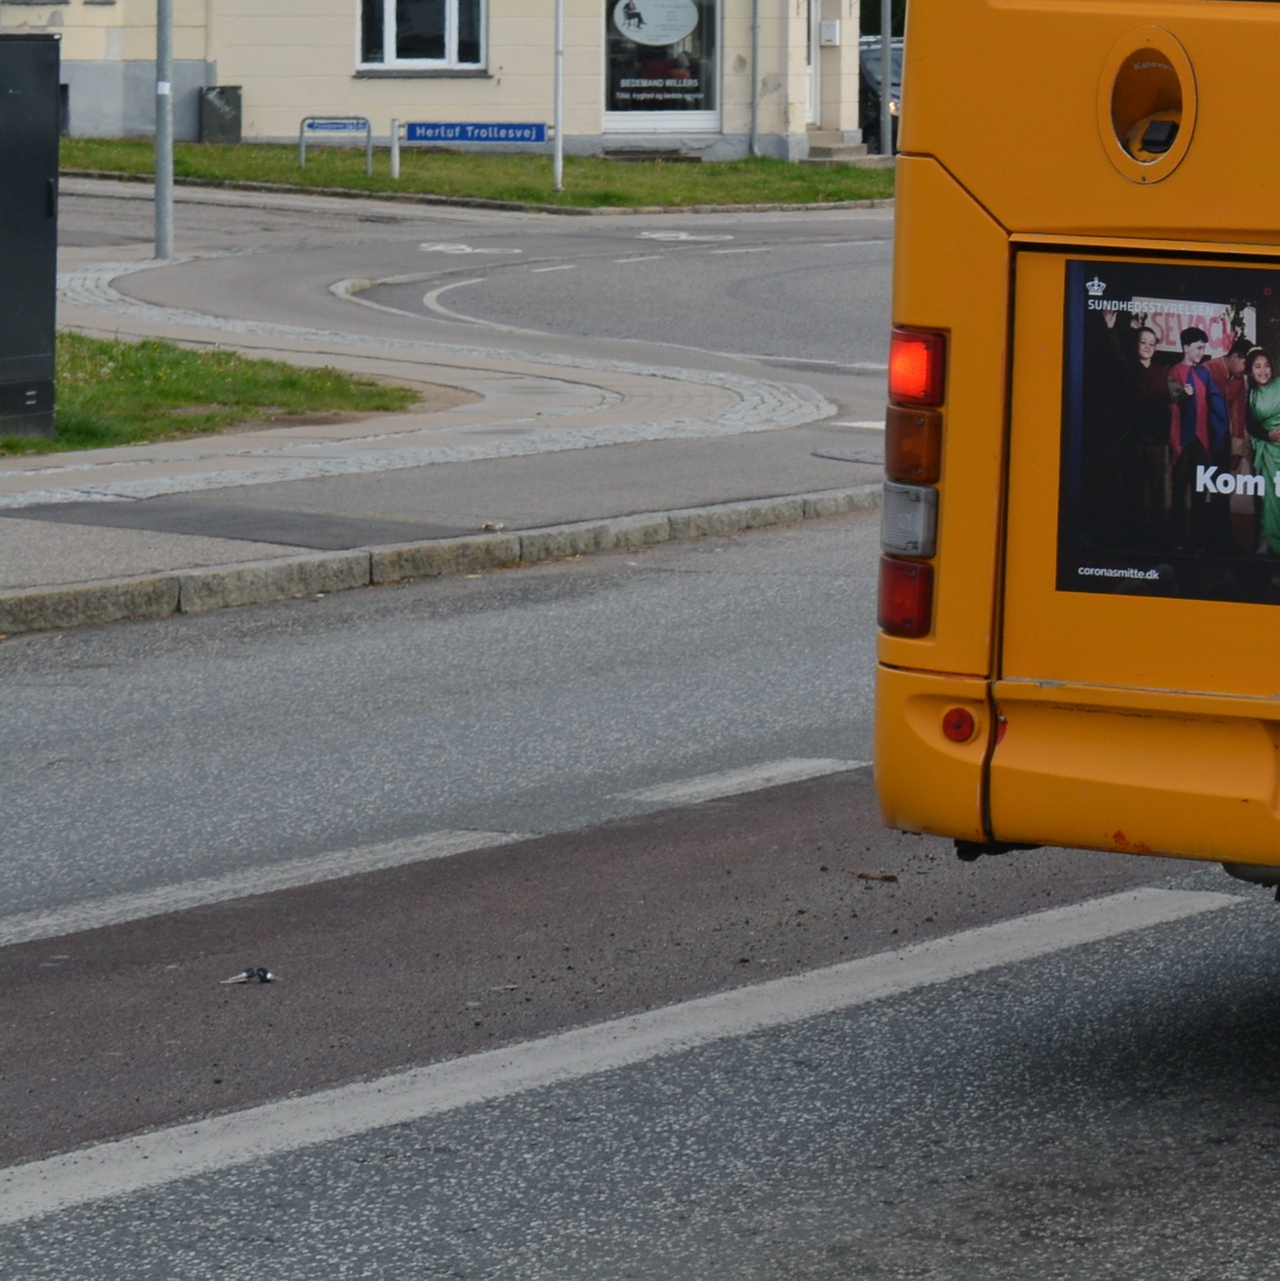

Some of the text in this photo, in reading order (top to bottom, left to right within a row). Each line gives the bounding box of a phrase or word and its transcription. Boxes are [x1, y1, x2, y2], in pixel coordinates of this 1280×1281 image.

[620, 79, 698, 87] BEDEMAND WILLERS
[416, 126, 536, 140] Herluf Trollesvej
[1087, 299, 1214, 316] SUNDHEDSSTYRELSEN
[1196, 465, 1265, 496] Kom
[1078, 567, 1160, 580] coronasmitte.dk
